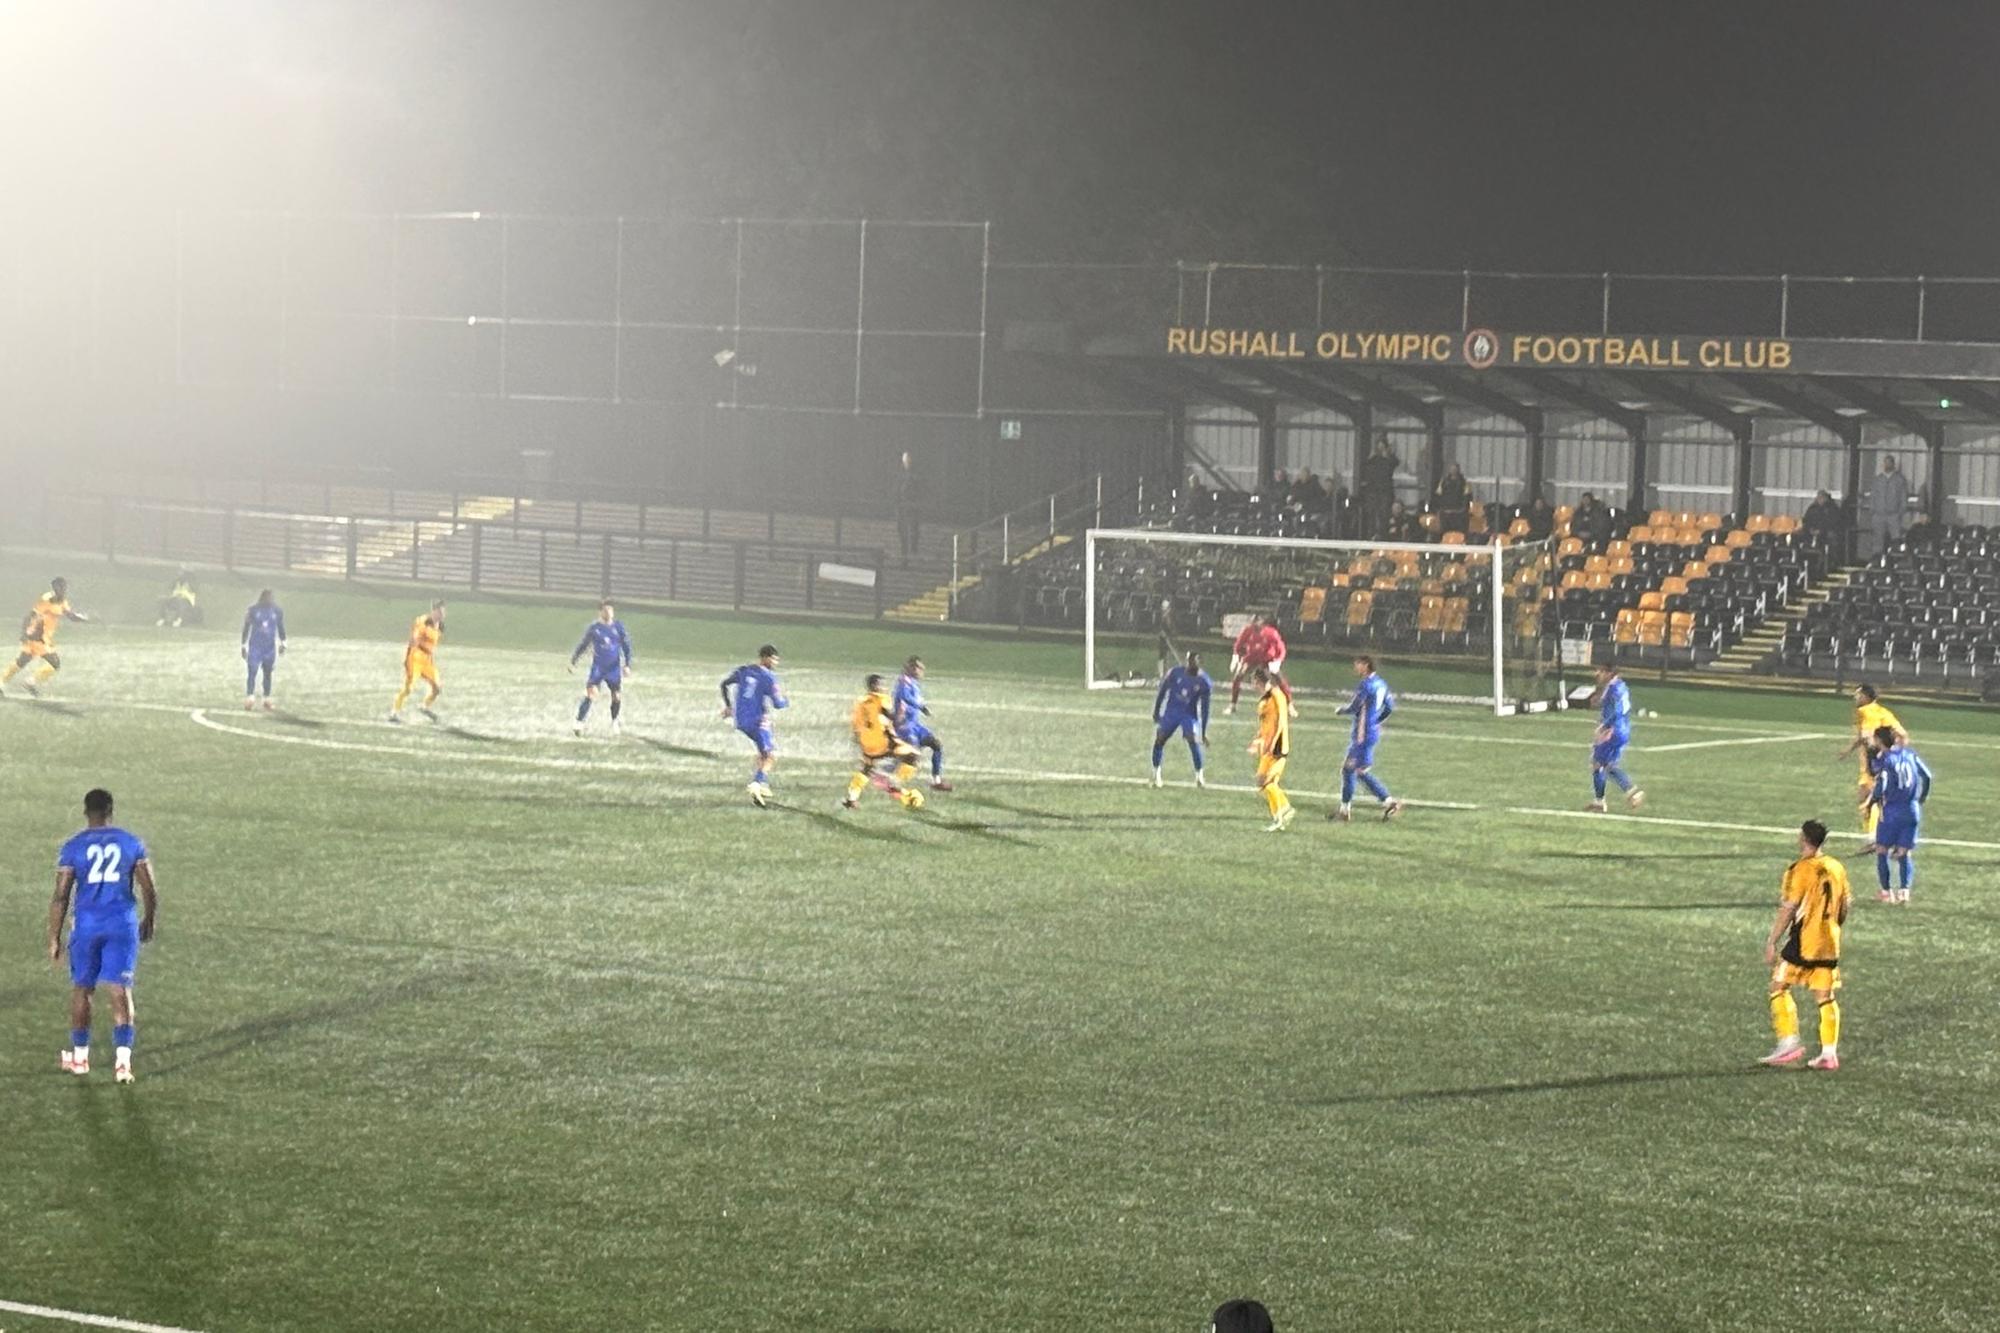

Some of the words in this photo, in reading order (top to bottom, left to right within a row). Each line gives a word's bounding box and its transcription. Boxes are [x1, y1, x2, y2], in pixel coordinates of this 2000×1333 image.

[1167, 328, 1305, 357] RUSHALL
[1316, 332, 1451, 361] OLYMPIC
[1513, 336, 1689, 366] FOOTBALL
[1700, 341, 1792, 368] CLUB
[86, 843, 121, 884] 22
